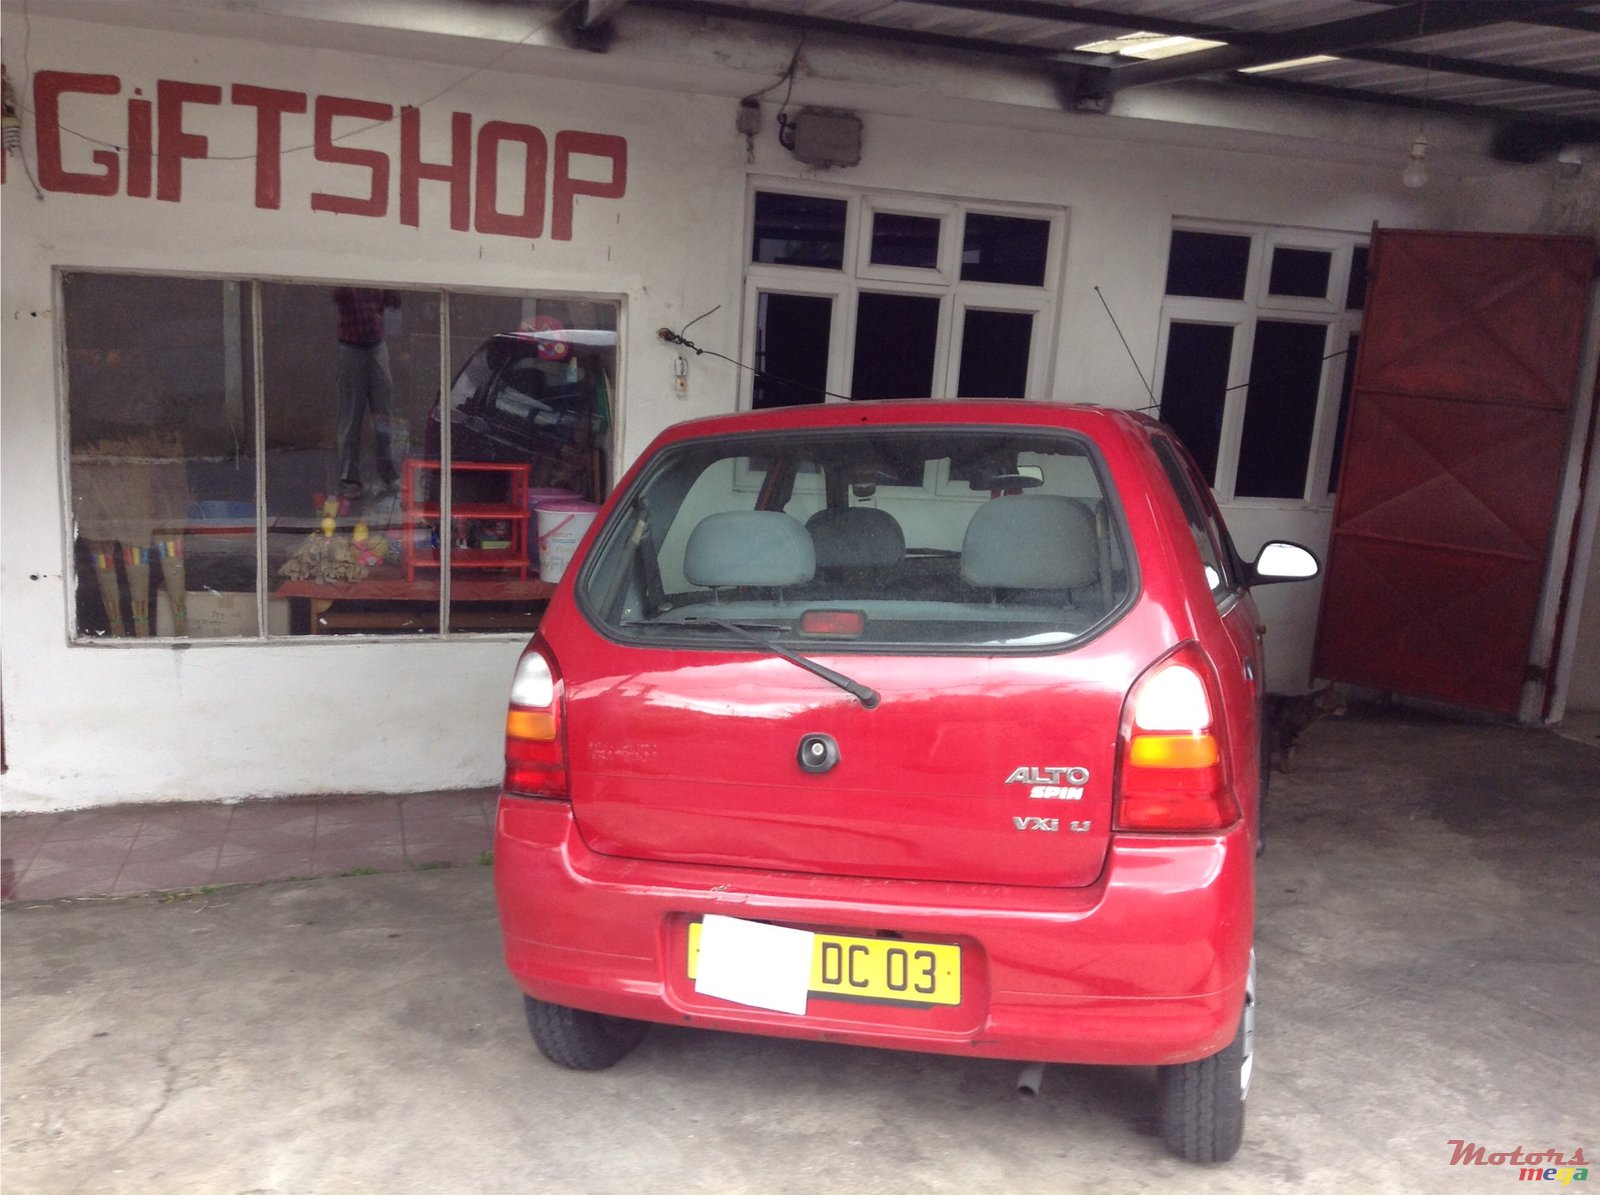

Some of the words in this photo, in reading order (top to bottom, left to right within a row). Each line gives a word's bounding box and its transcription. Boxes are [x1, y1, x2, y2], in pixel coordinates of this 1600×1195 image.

[1004, 766, 1090, 786] ALTO
[1029, 786, 1084, 800] SPIN
[1012, 816, 1059, 832] VXi
[822, 942, 870, 988] DC
[886, 948, 937, 994] 03
